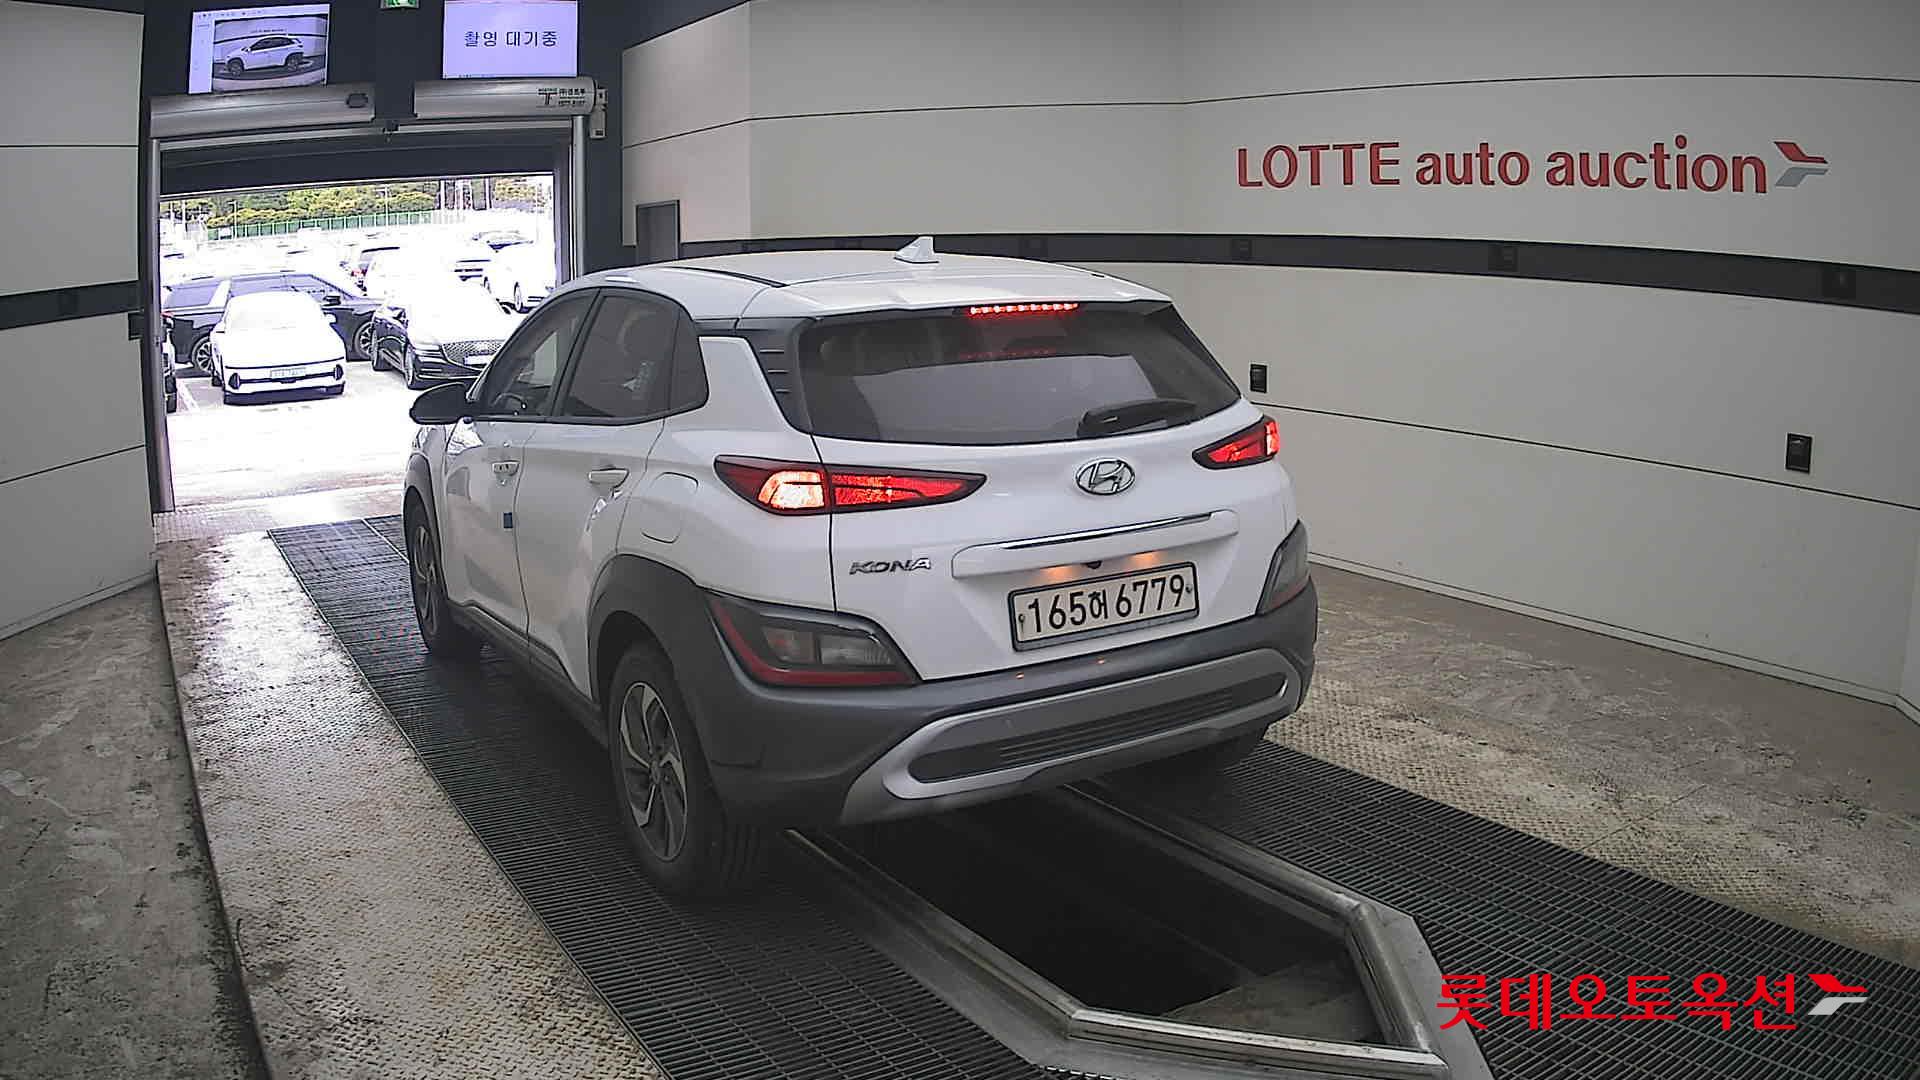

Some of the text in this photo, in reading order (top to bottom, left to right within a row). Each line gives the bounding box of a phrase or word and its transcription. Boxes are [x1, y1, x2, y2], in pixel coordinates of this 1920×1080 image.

[506, 31, 558, 47] 대기중
[1236, 134, 1768, 194] LOTTE auto auction
[848, 557, 932, 575] KONA
